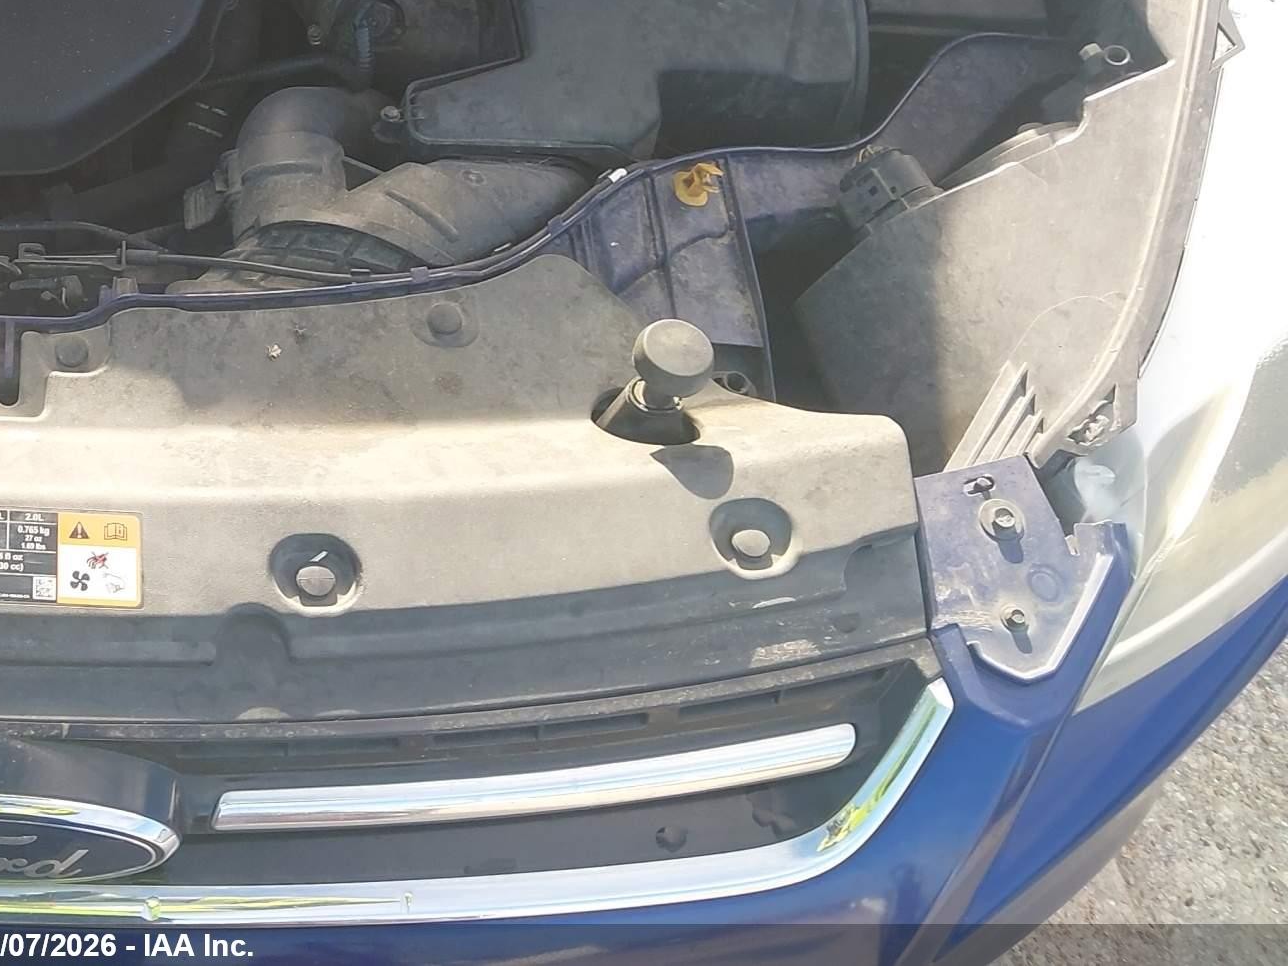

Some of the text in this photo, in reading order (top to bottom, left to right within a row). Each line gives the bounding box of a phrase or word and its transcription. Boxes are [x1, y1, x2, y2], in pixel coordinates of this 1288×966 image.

[25, 513, 44, 521] 2.0L
[40, 527, 50, 536] kg
[10, 562, 24, 572] cc)
